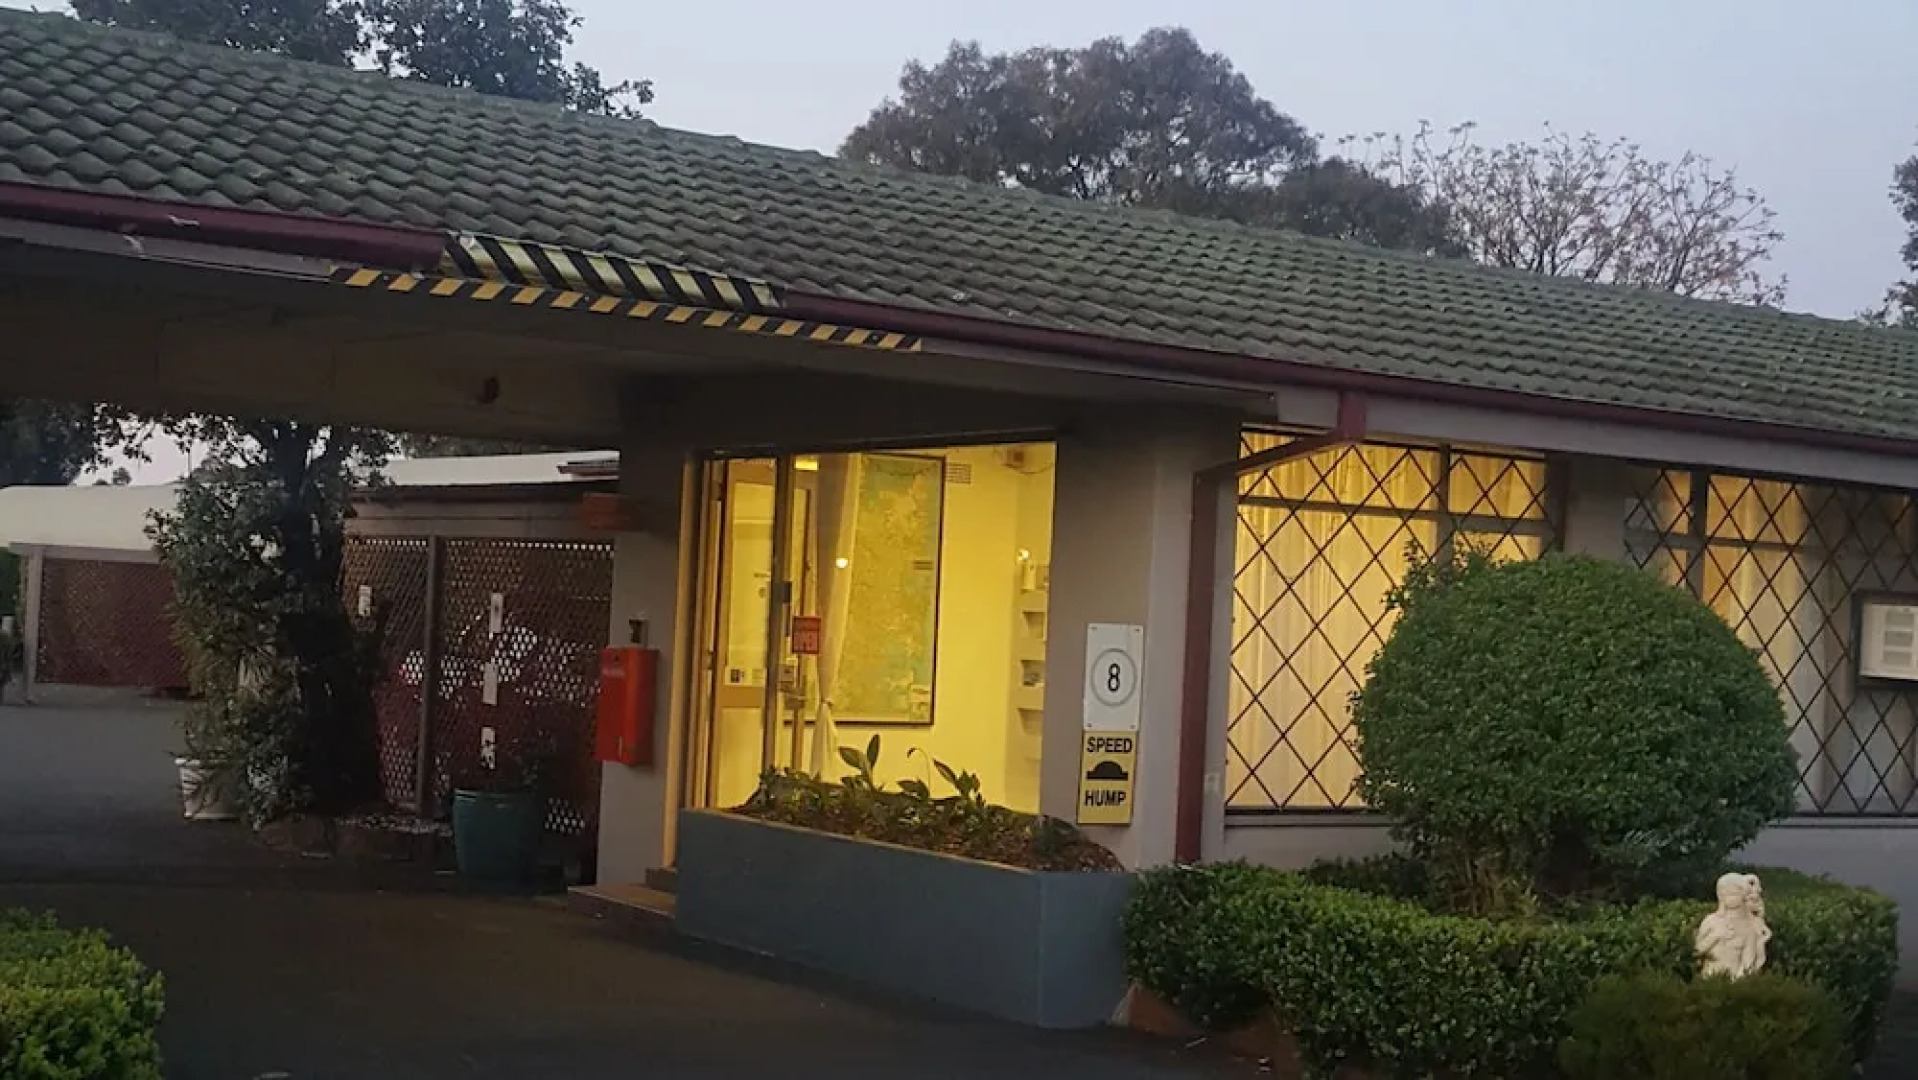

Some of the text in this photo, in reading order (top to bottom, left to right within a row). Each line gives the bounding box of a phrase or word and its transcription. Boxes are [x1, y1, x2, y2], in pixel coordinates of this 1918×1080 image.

[1107, 663, 1121, 692] 8
[1086, 736, 1133, 754] SPEED
[1084, 790, 1127, 807] HUMP
